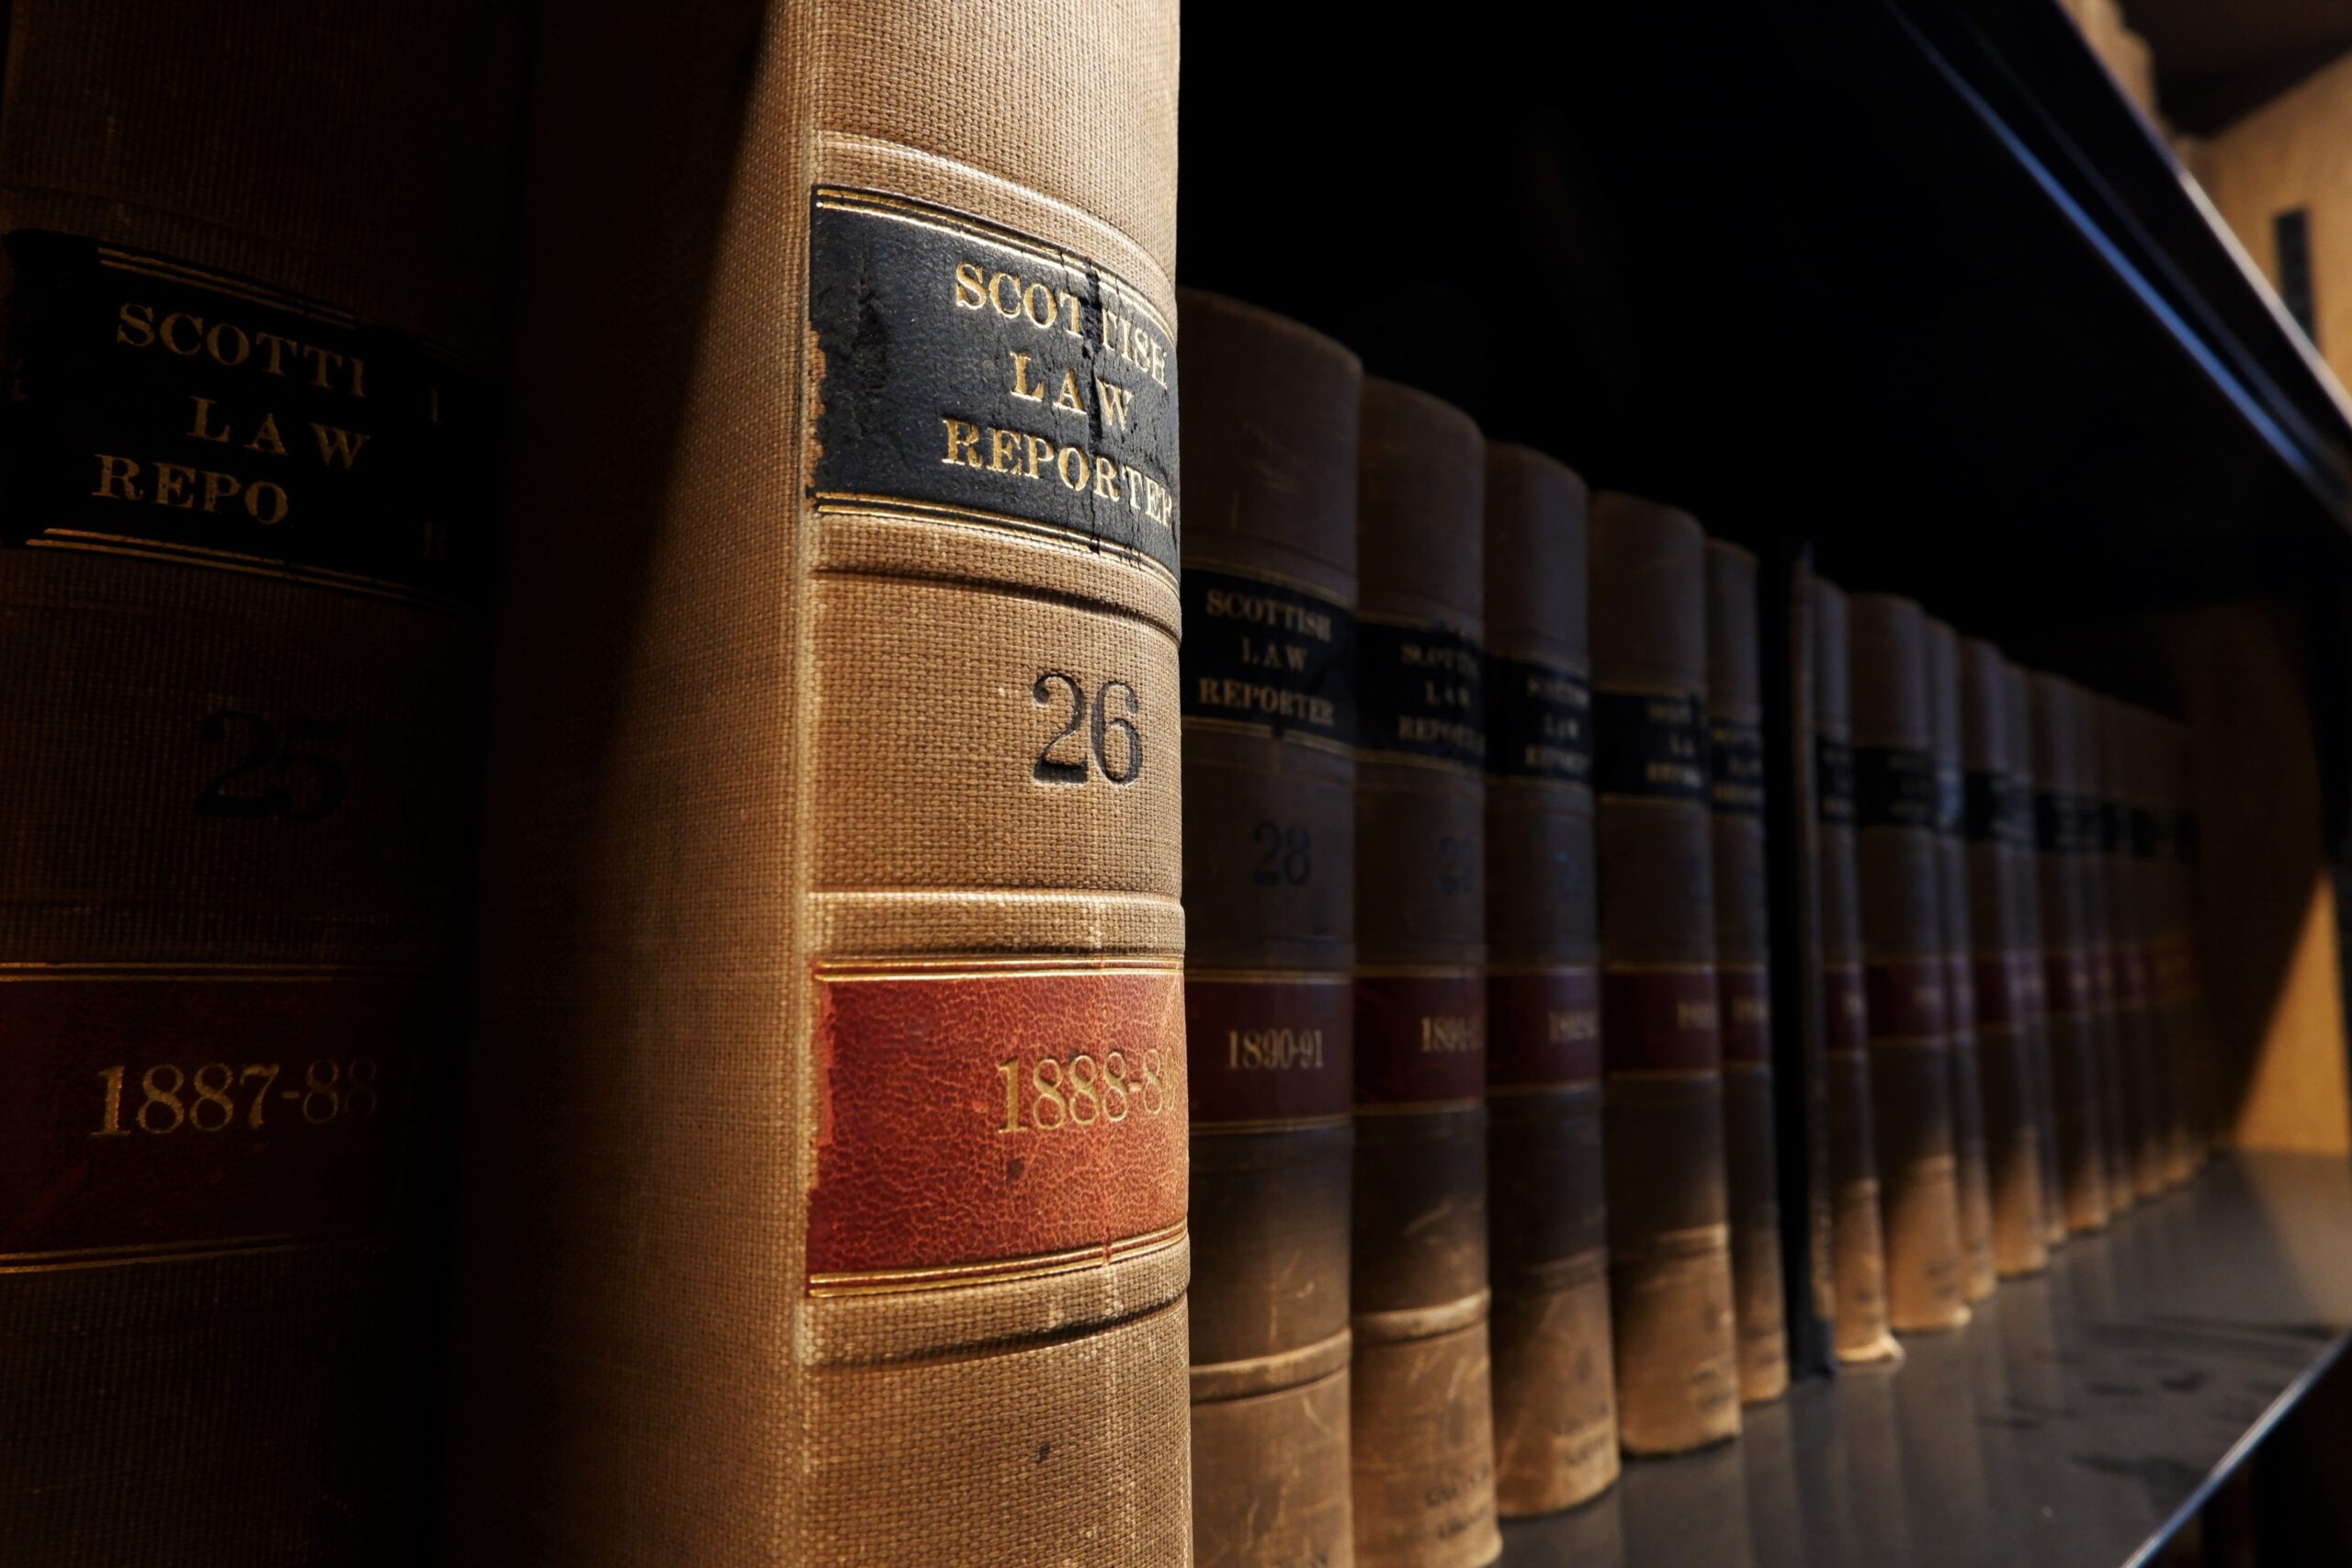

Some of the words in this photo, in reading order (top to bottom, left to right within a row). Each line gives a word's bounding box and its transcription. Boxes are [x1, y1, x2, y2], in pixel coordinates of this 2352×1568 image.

[116, 301, 368, 400] SCOTTI
[1010, 351, 1133, 432] LAW
[187, 395, 370, 471] LAW
[90, 453, 291, 527] REPO
[941, 416, 1172, 530] REPORTER
[1205, 588, 1331, 642] SCOTTISH
[1239, 634, 1308, 672] LAW
[1033, 671, 1143, 785] 26
[1197, 676, 1335, 727] REPORTER
[195, 710, 345, 820] 25
[1252, 822, 1310, 886] 28
[1225, 1028, 1325, 1070] 1890-91
[92, 1058, 378, 1139] 1887-88
